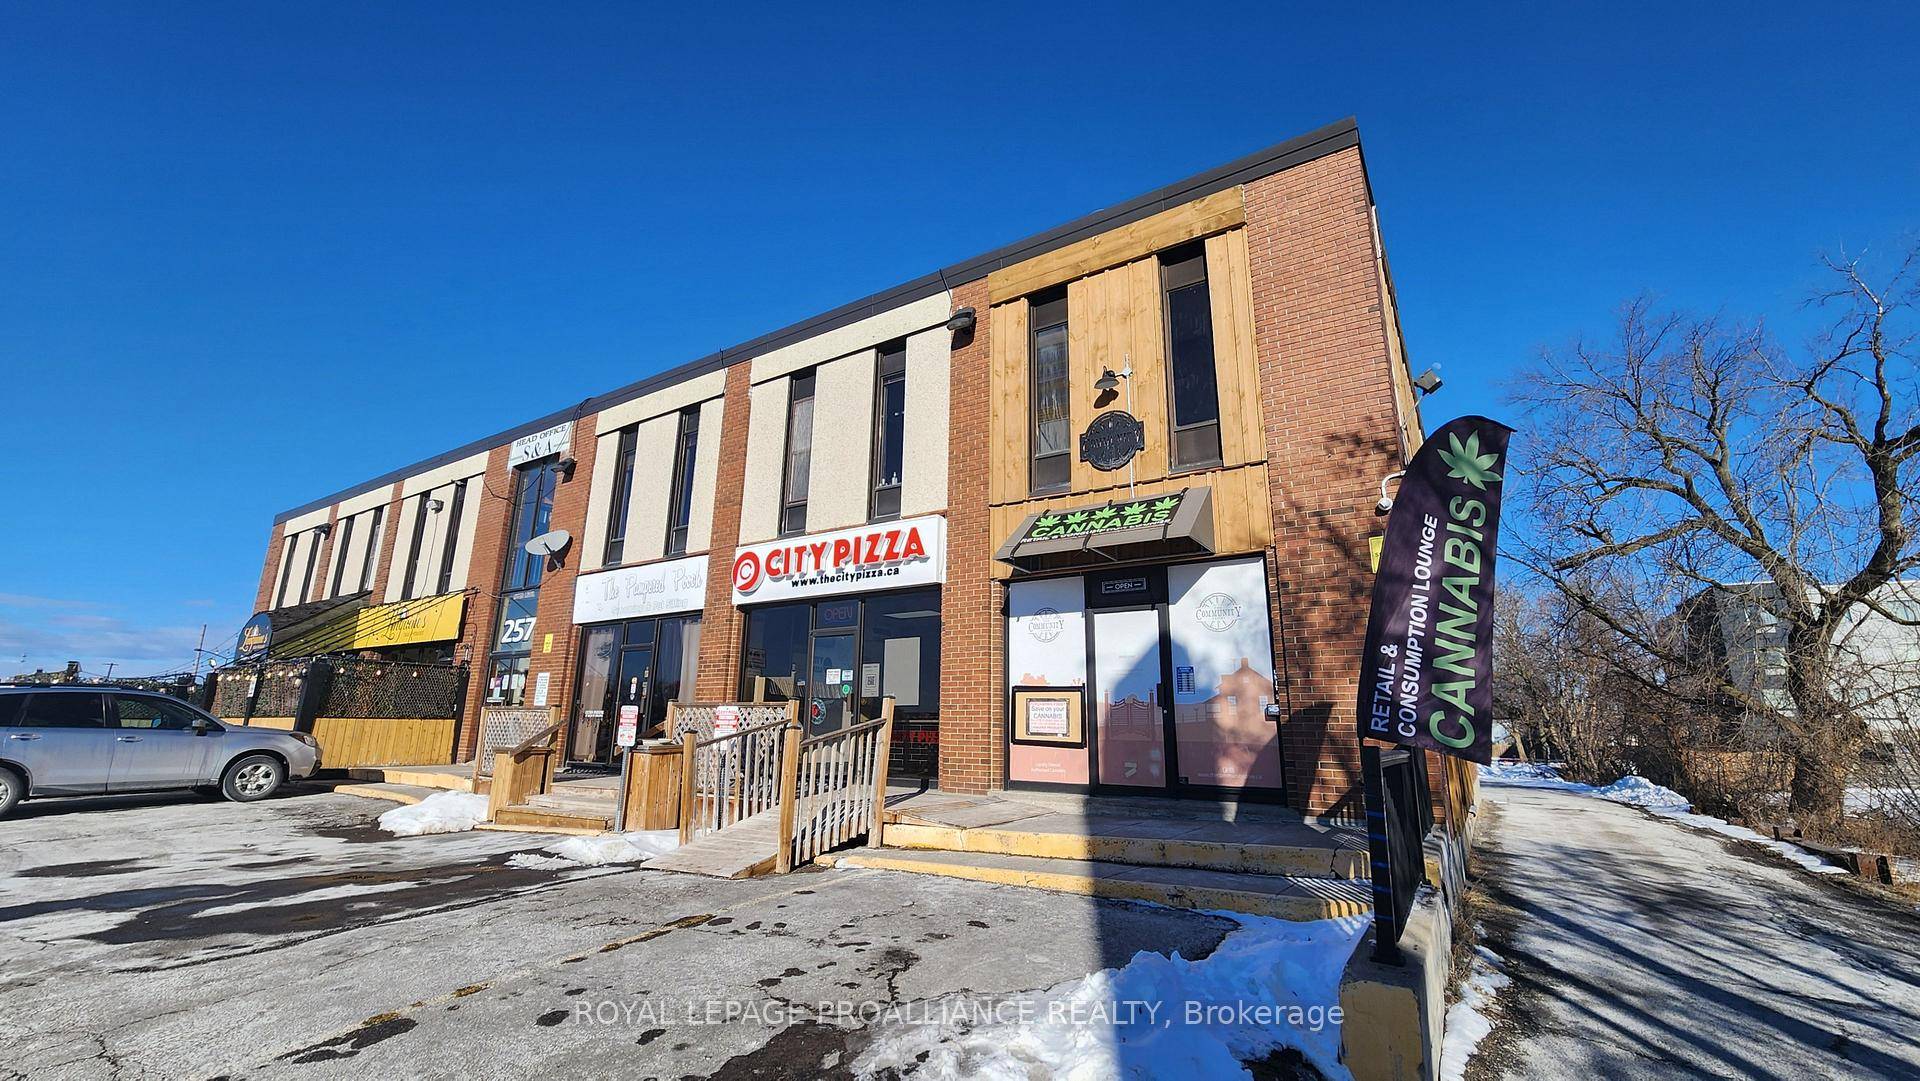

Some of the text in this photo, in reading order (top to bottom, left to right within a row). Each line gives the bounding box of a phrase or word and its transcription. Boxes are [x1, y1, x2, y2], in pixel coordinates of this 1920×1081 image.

[516, 424, 567, 447] HEAD OFFICE
[1031, 509, 1171, 538] CANNABIS
[765, 527, 927, 578] CITY PIZZA
[602, 577, 619, 601] The
[791, 567, 900, 588] www.thecitypizza.ca
[1114, 582, 1133, 590] OPEN
[824, 606, 853, 621] OPEN
[1196, 606, 1242, 621] COMMUNITY
[1397, 513, 1438, 738] CONSUMPTION LOUNGE
[1429, 495, 1487, 749] CANNABIS
[501, 617, 537, 643] 257
[1371, 643, 1399, 732] RETAIL &
